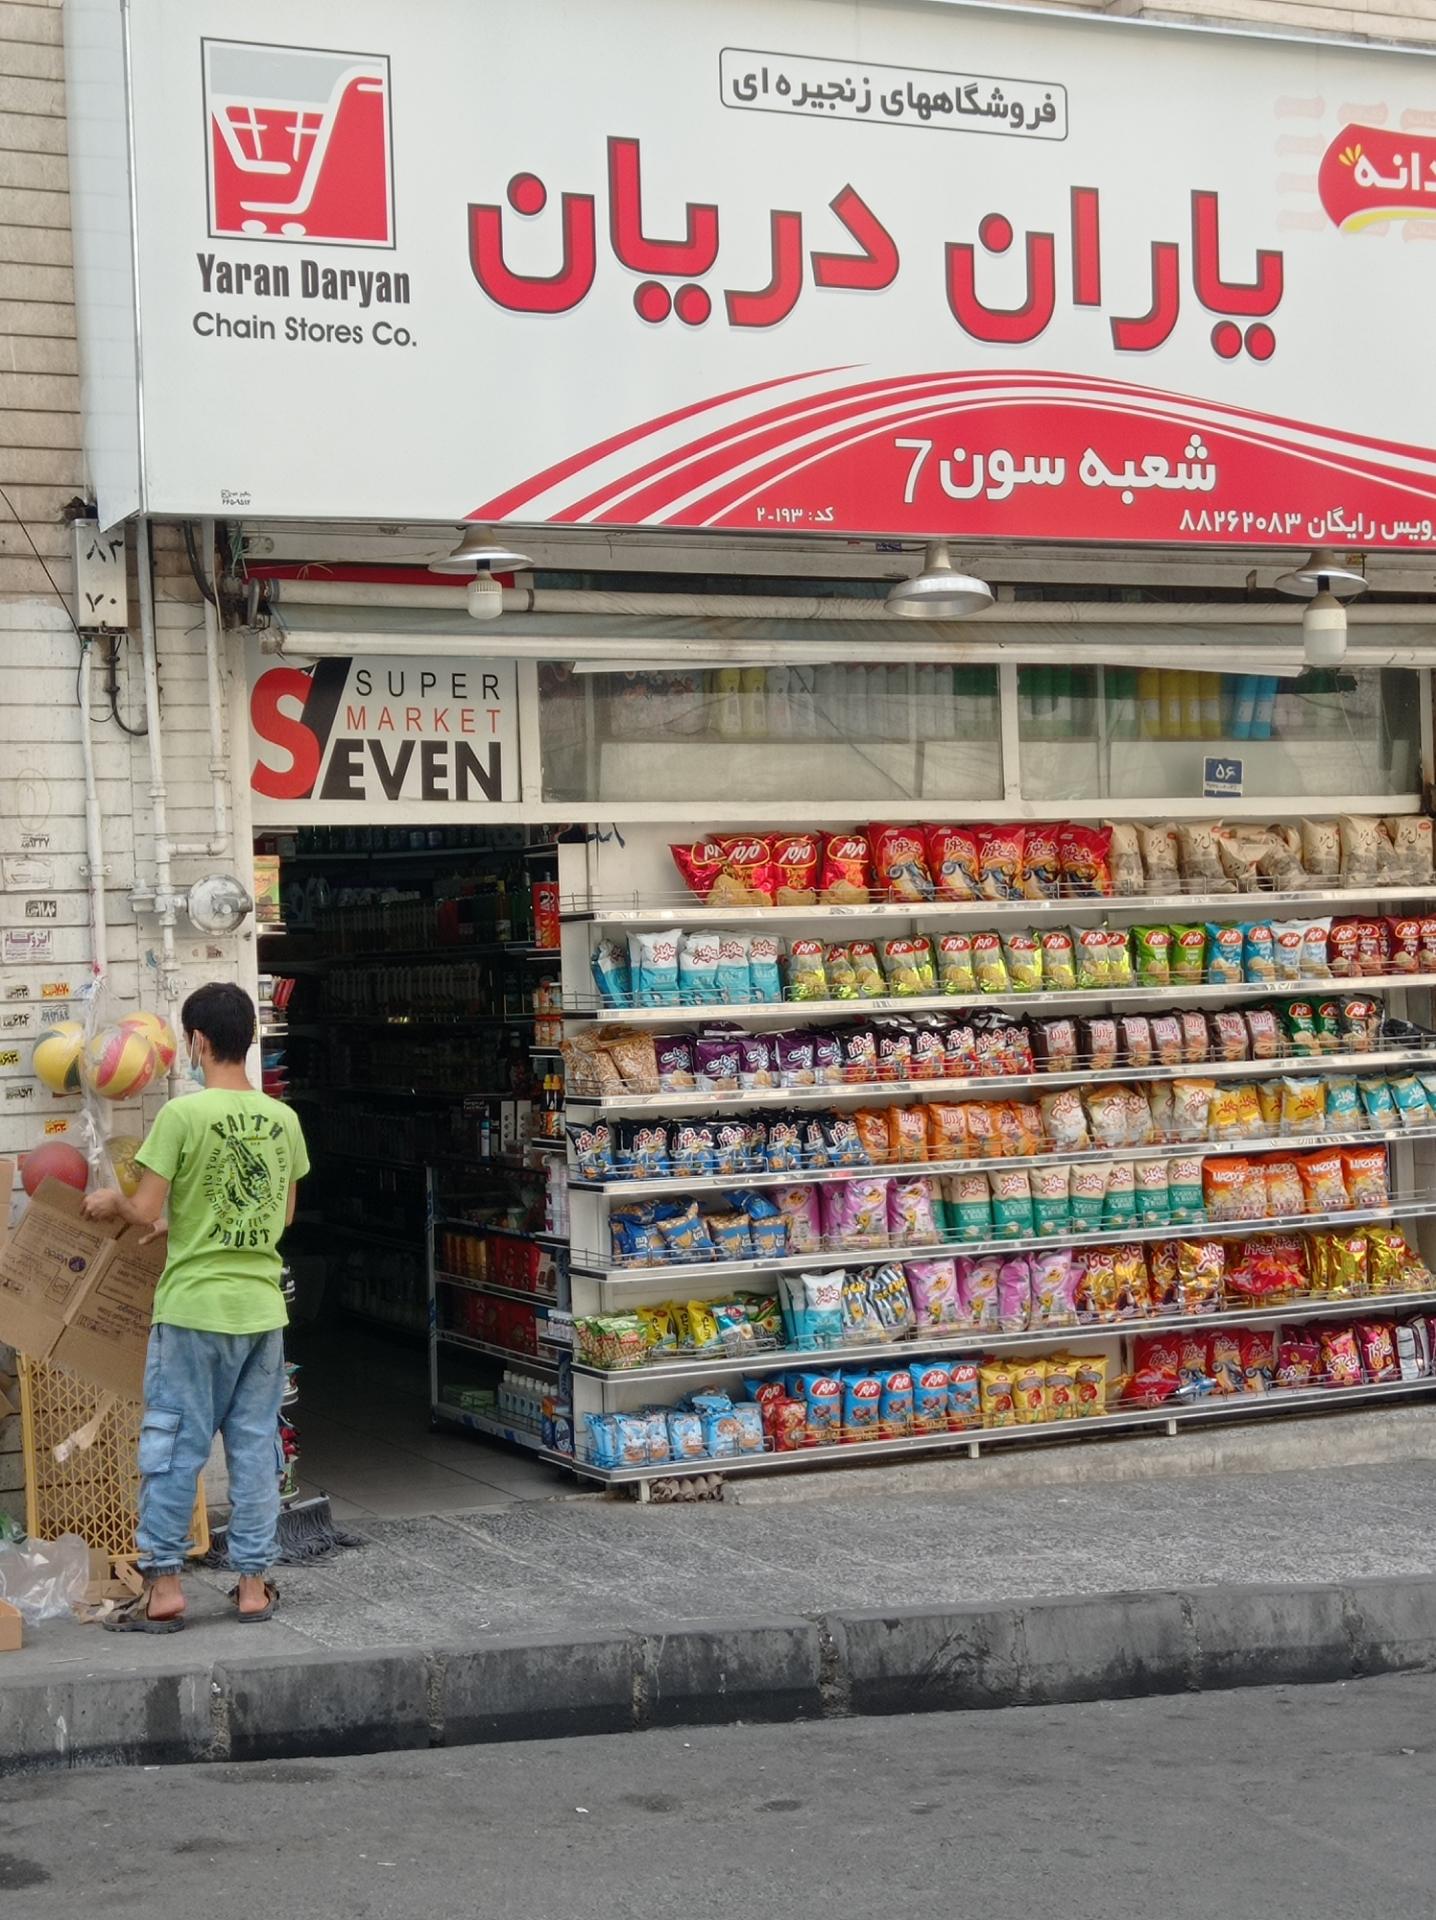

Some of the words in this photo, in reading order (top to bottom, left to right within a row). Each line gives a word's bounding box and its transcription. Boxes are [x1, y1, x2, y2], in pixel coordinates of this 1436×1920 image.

[880, 82, 1057, 131] فروشگاههای
[466, 135, 901, 328] دریان
[196, 252, 290, 298] Yaran
[300, 259, 411, 309] Daryan
[943, 184, 1285, 361] یاران
[192, 311, 276, 340] Chain
[284, 316, 364, 345] Stores
[371, 321, 418, 347] Co.
[894, 437, 934, 504] 7
[938, 446, 1066, 502] سون
[1078, 433, 1217, 505] شعبه
[1179, 509, 1302, 535] ۸۸۲۶۲۰۸۳
[1307, 506, 1376, 540] رایگان
[1381, 519, 1436, 542] ویس
[355, 669, 501, 700] SUPER
[250, 666, 502, 803] SEVEN
[346, 705, 502, 734] MARKET
[210, 1112, 283, 1140] FAITH
[208, 1223, 271, 1249] TRUST
